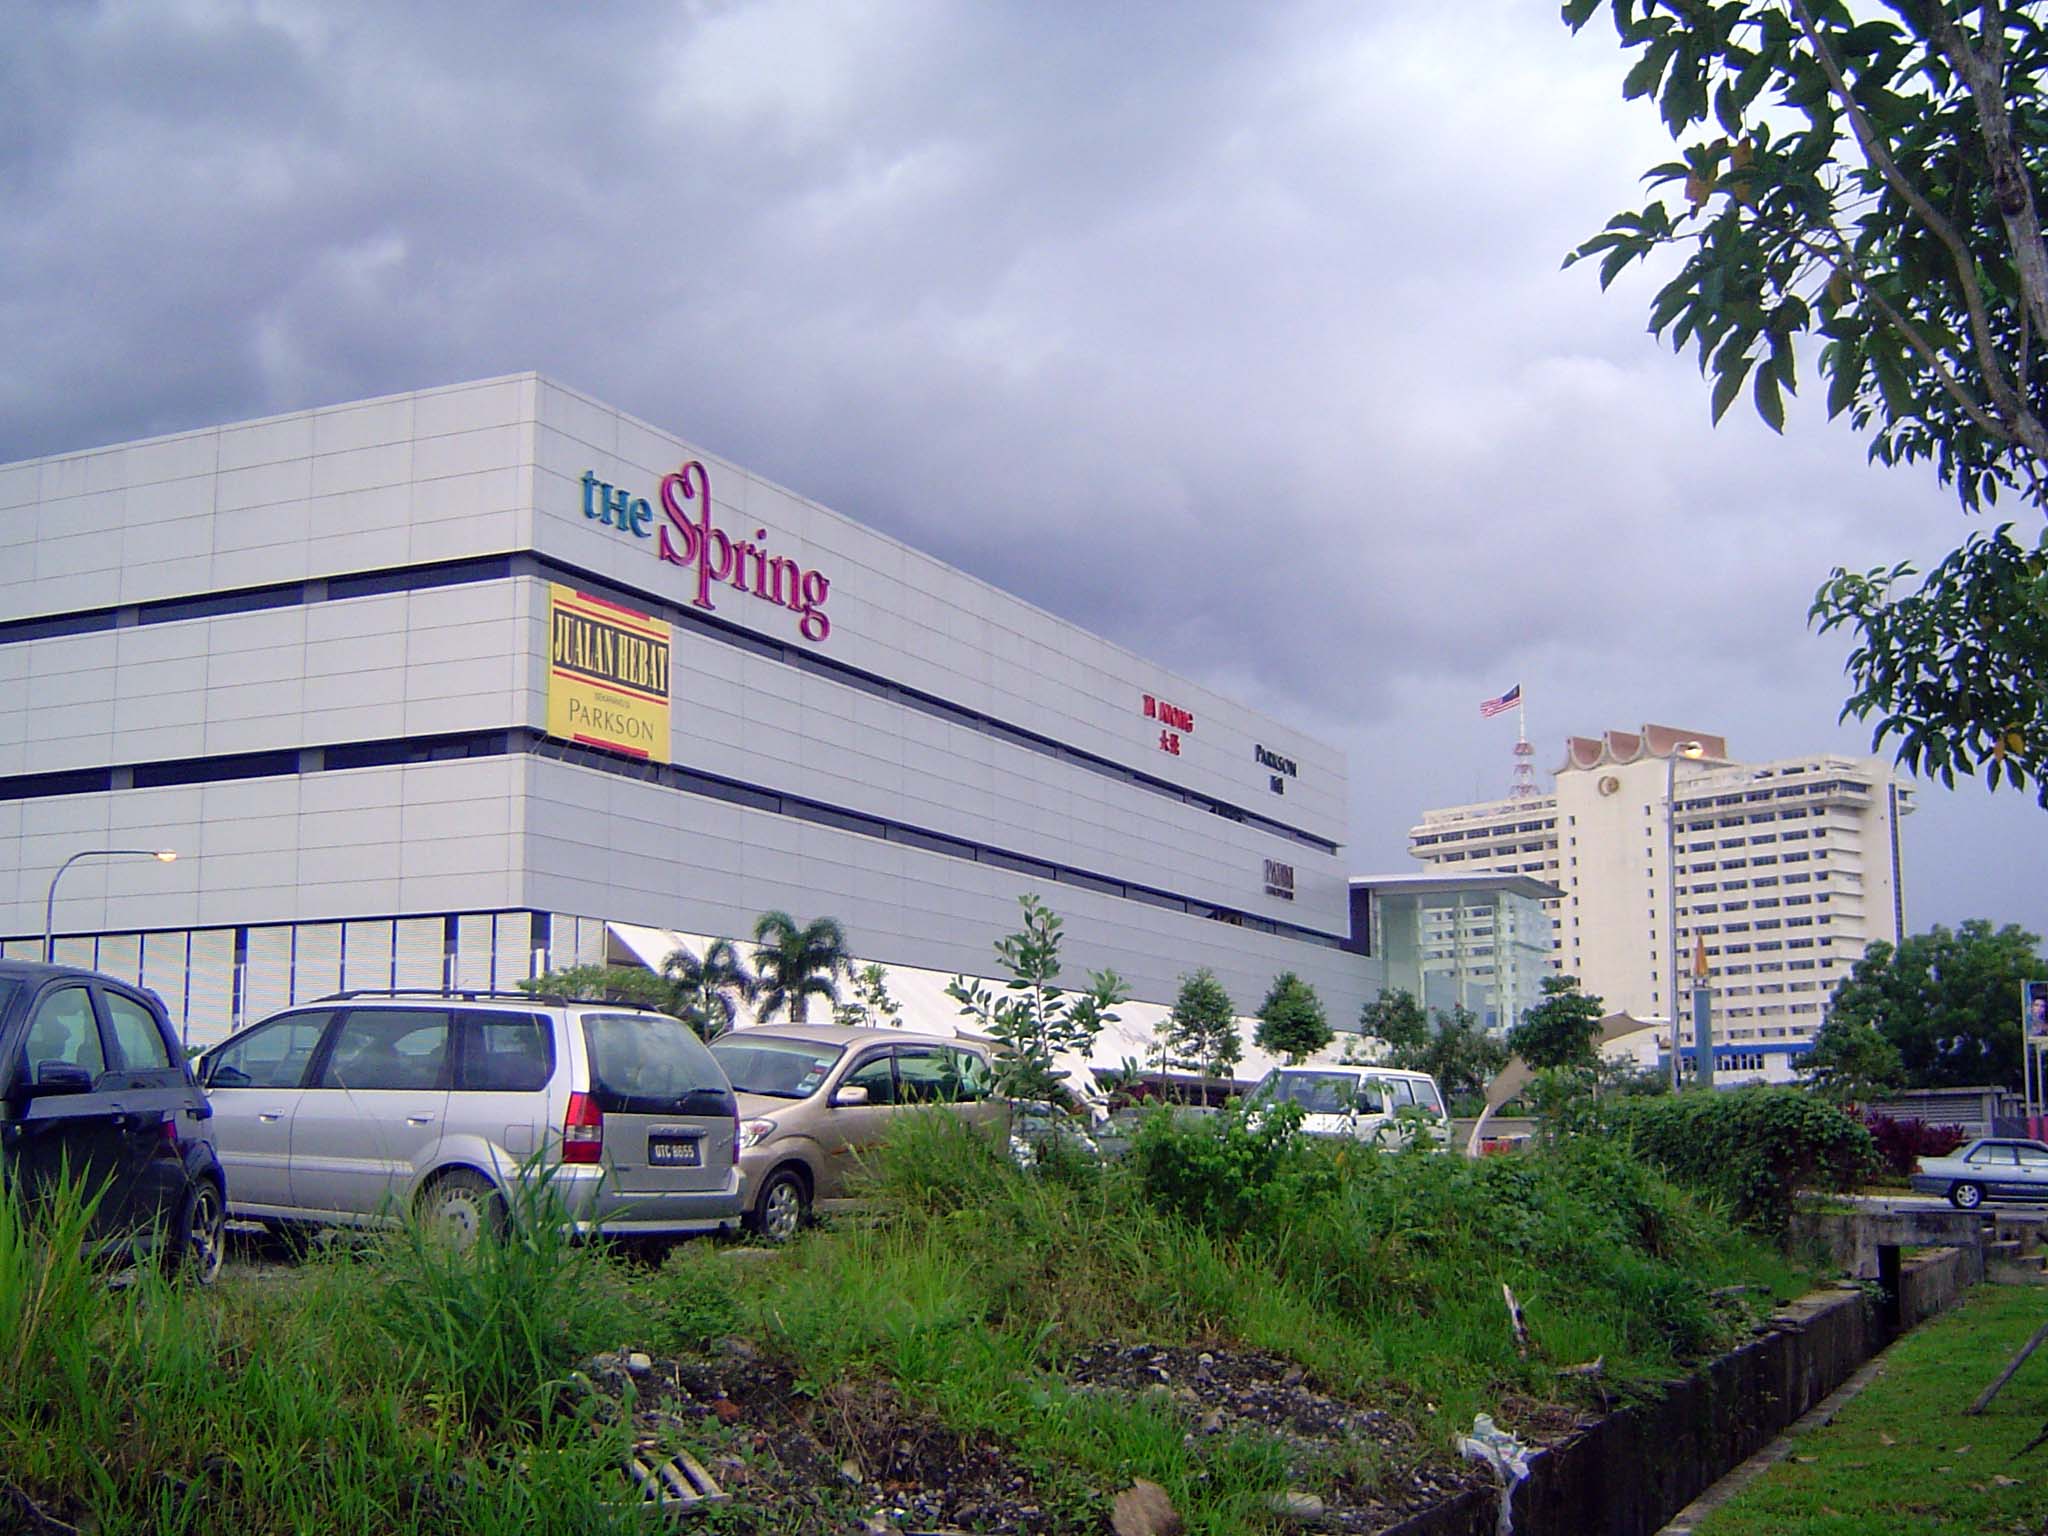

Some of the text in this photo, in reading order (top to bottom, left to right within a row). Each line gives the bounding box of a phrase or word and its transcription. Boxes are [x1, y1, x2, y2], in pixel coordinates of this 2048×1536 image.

[659, 460, 831, 642] Spring
[555, 613, 667, 692] JUALAN HEBAT
[569, 697, 655, 741] PARKSON
